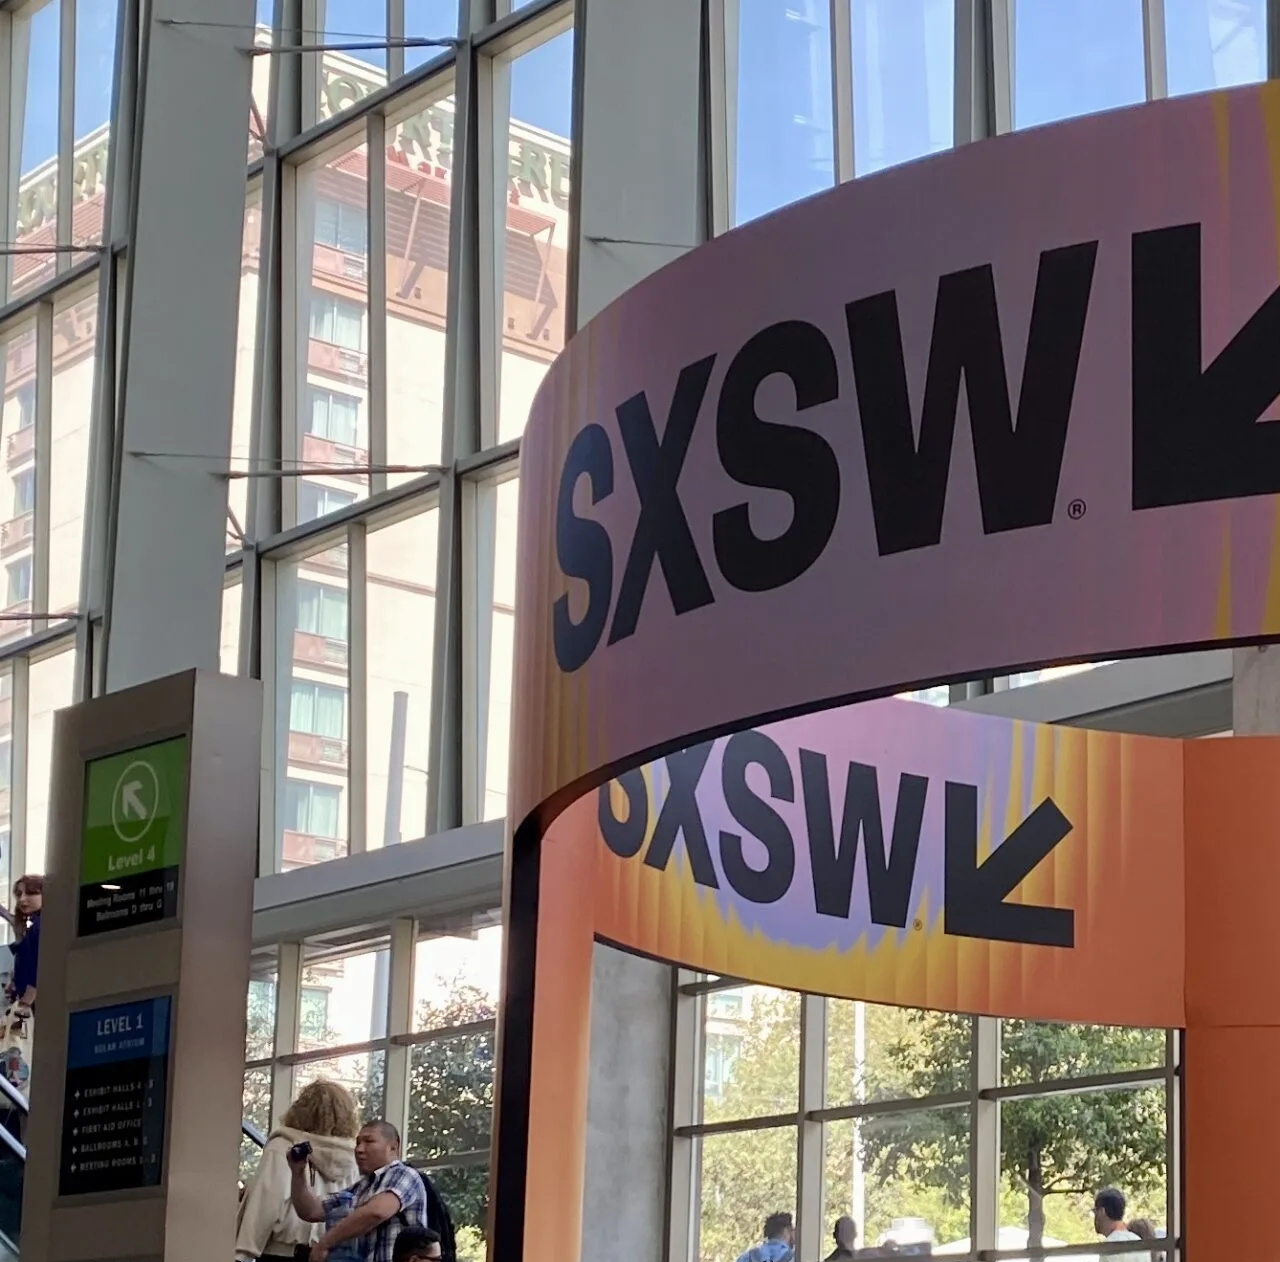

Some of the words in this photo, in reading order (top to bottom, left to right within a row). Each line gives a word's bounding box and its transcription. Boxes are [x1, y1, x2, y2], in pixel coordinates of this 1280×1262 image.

[107, 848, 144, 871] Level
[147, 845, 155, 861] 4
[97, 1016, 132, 1036] LEVEL
[136, 1013, 144, 1029] 1
